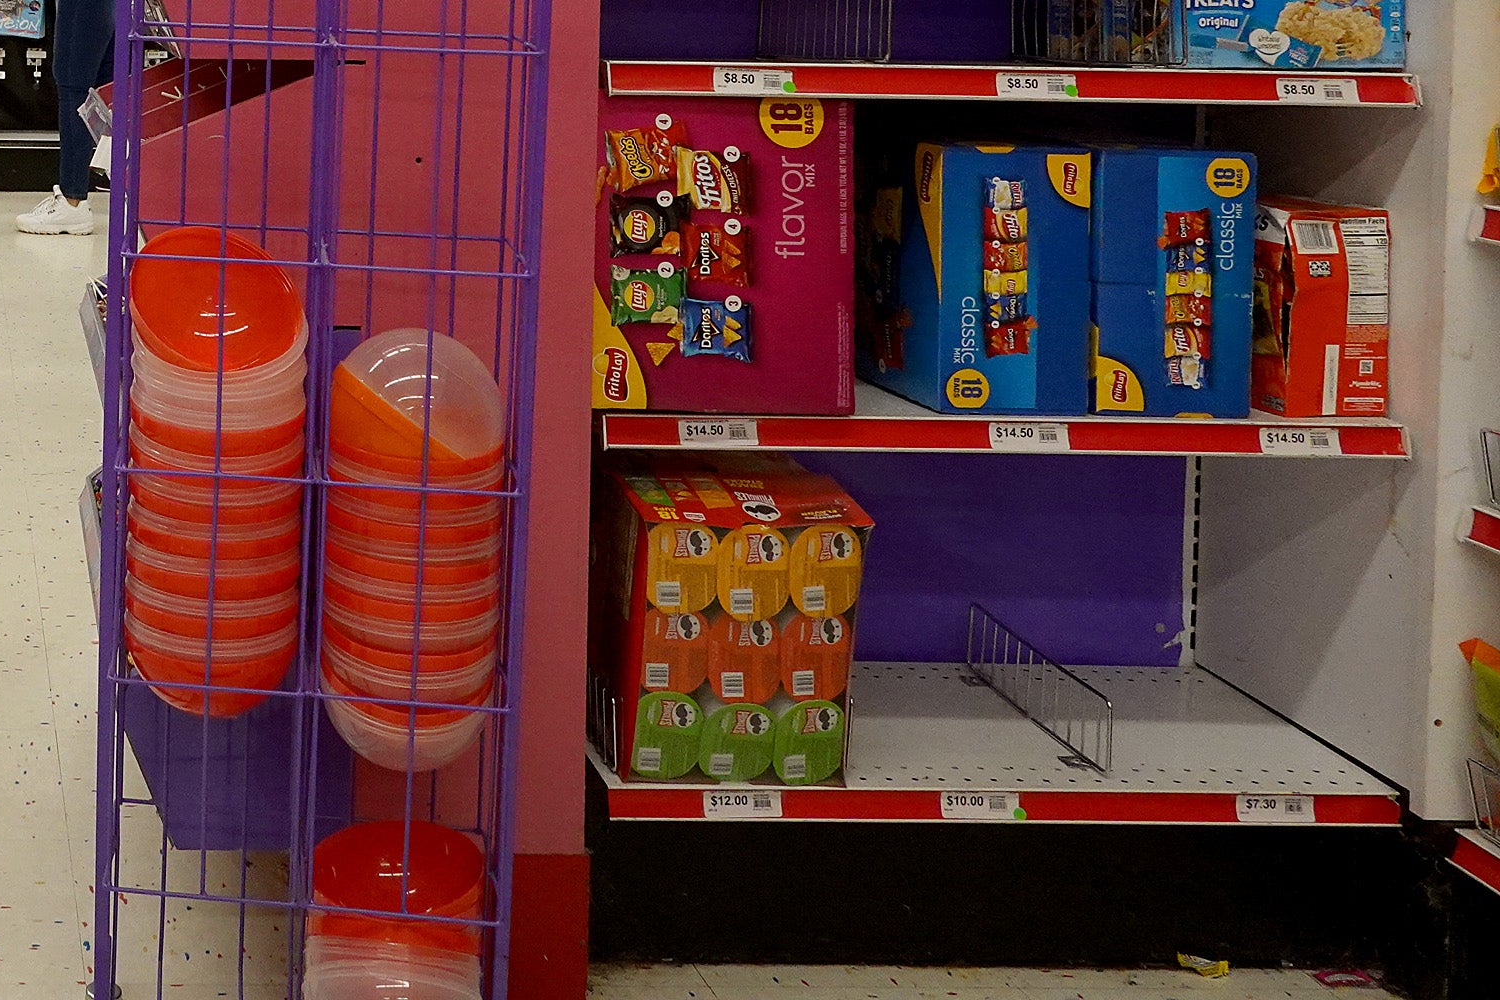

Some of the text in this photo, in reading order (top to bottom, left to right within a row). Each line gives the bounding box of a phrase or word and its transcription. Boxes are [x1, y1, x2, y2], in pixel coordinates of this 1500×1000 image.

[724, 74, 755, 84] $8.50
[1007, 79, 1038, 89] $8.50
[1284, 85, 1315, 96] $8.50
[770, 102, 802, 134] 18
[774, 156, 806, 260] flavor
[1216, 202, 1236, 270] classic
[961, 296, 980, 364] classic
[686, 425, 723, 437] $14.50
[996, 427, 1033, 439] $14.50
[1267, 433, 1305, 444] $14.50
[711, 795, 748, 806] $12.00
[946, 796, 983, 808] $10.00
[1246, 799, 1276, 810] $7.30
